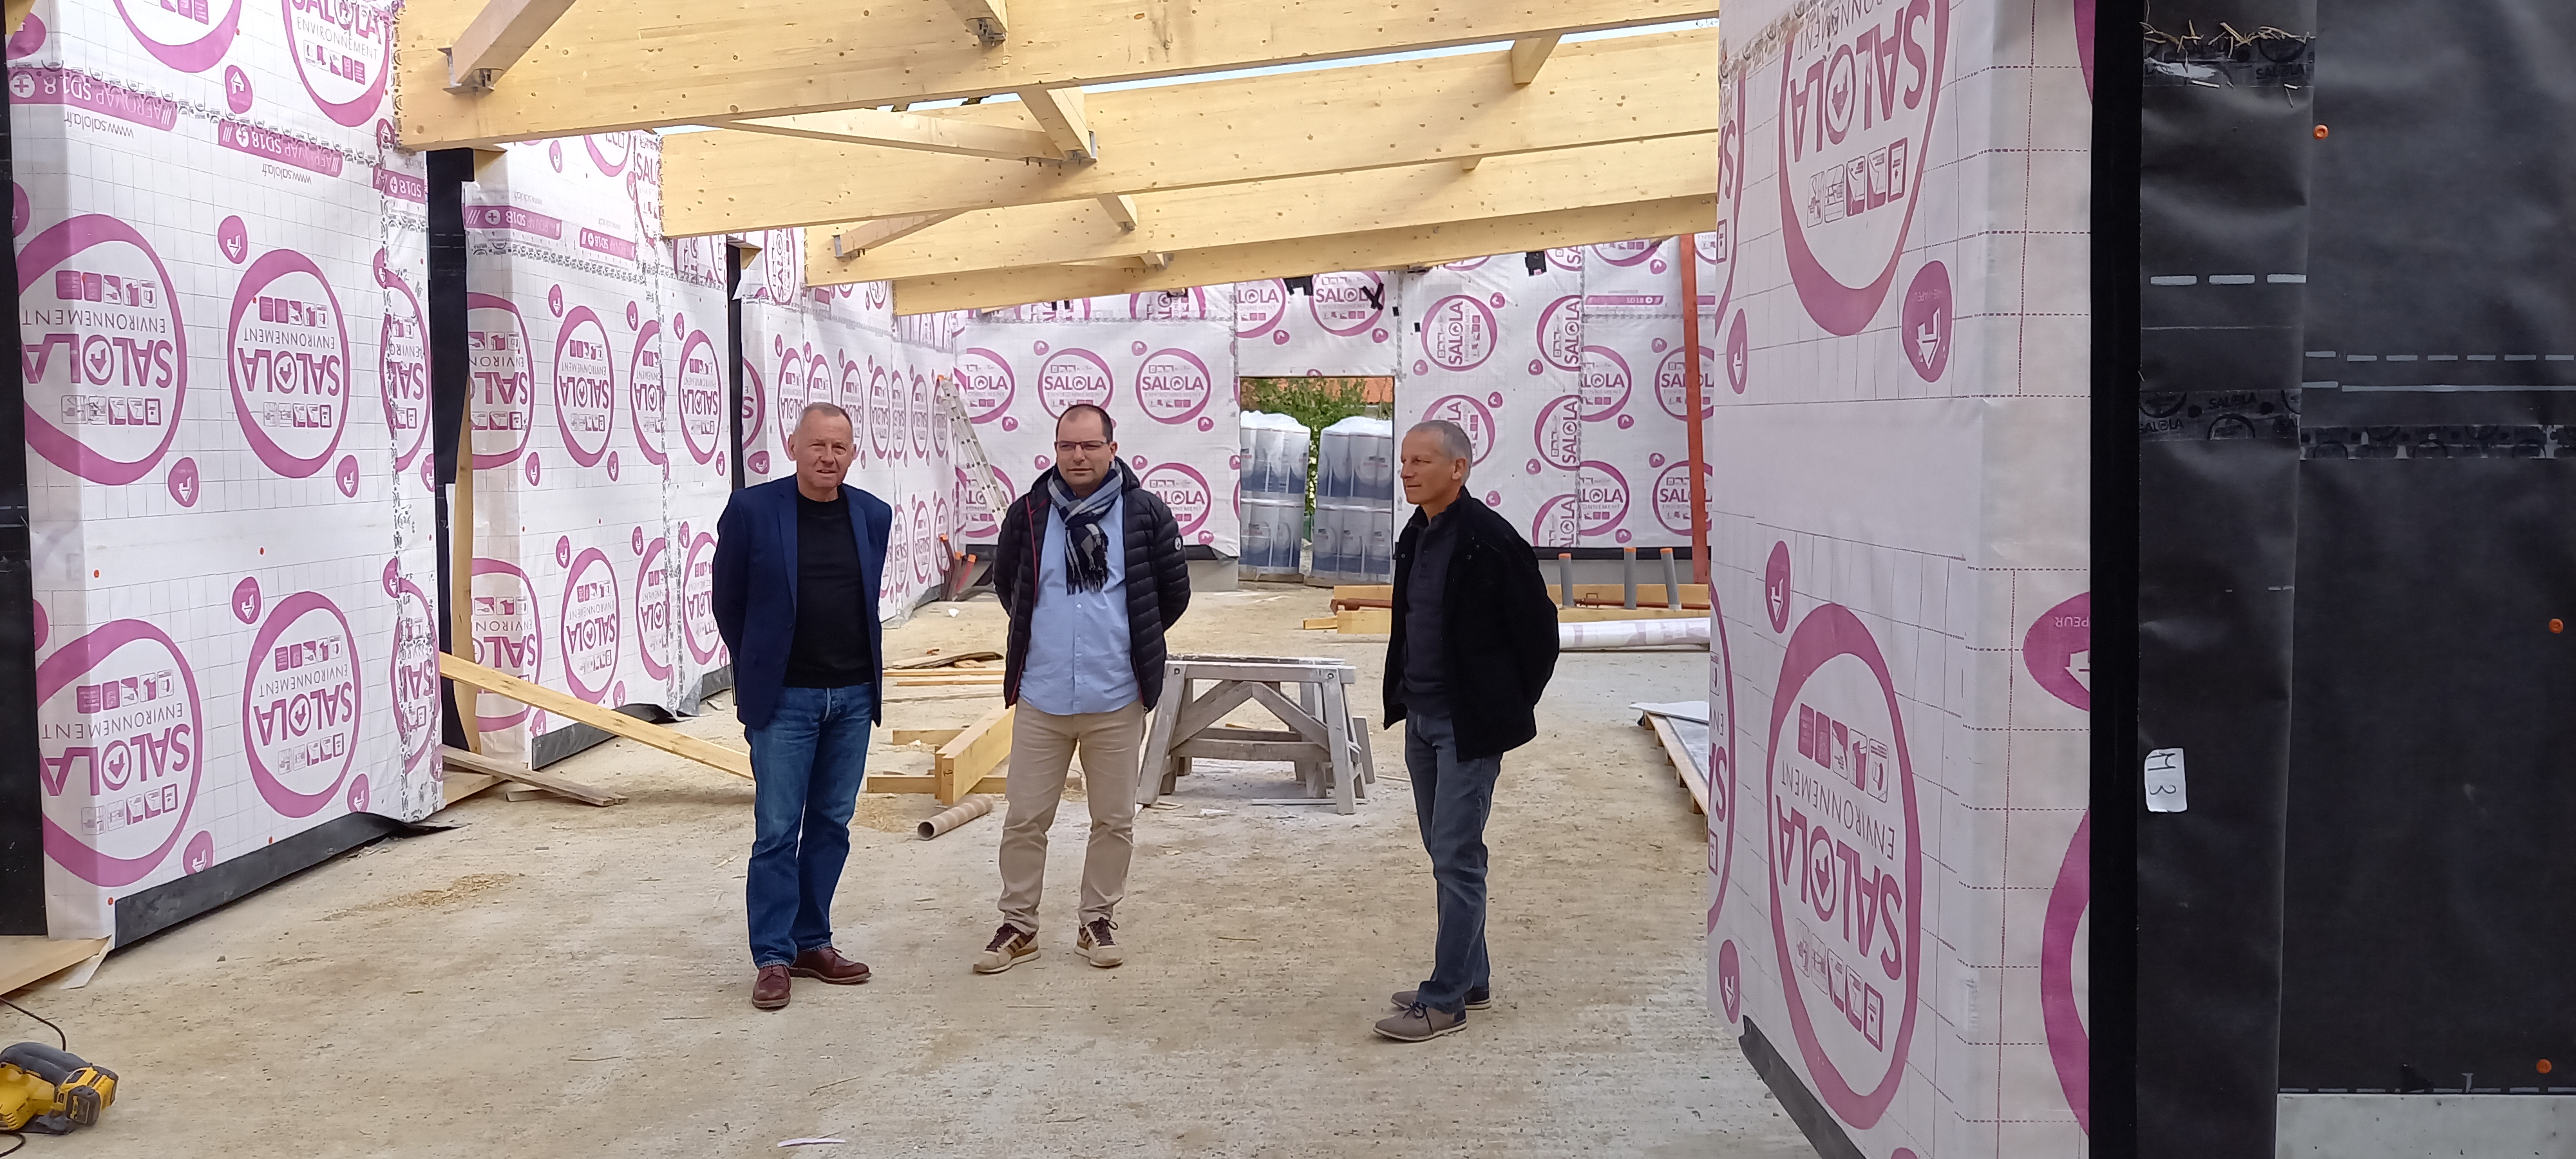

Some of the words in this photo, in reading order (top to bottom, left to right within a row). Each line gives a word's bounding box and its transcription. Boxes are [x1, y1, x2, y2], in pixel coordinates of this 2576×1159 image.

[297, 16, 377, 61] ENVIRONNEMENT
[1790, 0, 1930, 164] SALOLA
[64, 111, 135, 138] www.salola.fr
[251, 131, 282, 155] SD18
[399, 180, 422, 198] SD18
[22, 309, 166, 334] ENVIRONNEMENT
[243, 327, 335, 350] ENVIRONNEMENT
[1448, 301, 1464, 365] SALOLA
[1564, 301, 1580, 364] SALOLA
[21, 333, 173, 388] SALOLA
[237, 347, 341, 396] SALOLA
[559, 375, 609, 410] SALOLA
[681, 388, 719, 415] SALOLA
[1044, 375, 1107, 391] SALOLA
[1142, 375, 1205, 391] SALOLA
[1562, 400, 1578, 464] SALOLA
[475, 619, 533, 632] ENVIRON
[566, 612, 616, 655] SALOLA
[259, 663, 348, 698] ENVIRONNEMENT
[42, 702, 183, 739] ENVIRONNEMENT
[253, 681, 353, 747] SALOLA
[39, 723, 191, 796] SALOLA
[1781, 760, 1895, 862] ENVIRONNEMENT
[1775, 794, 1903, 981] SALOLA
